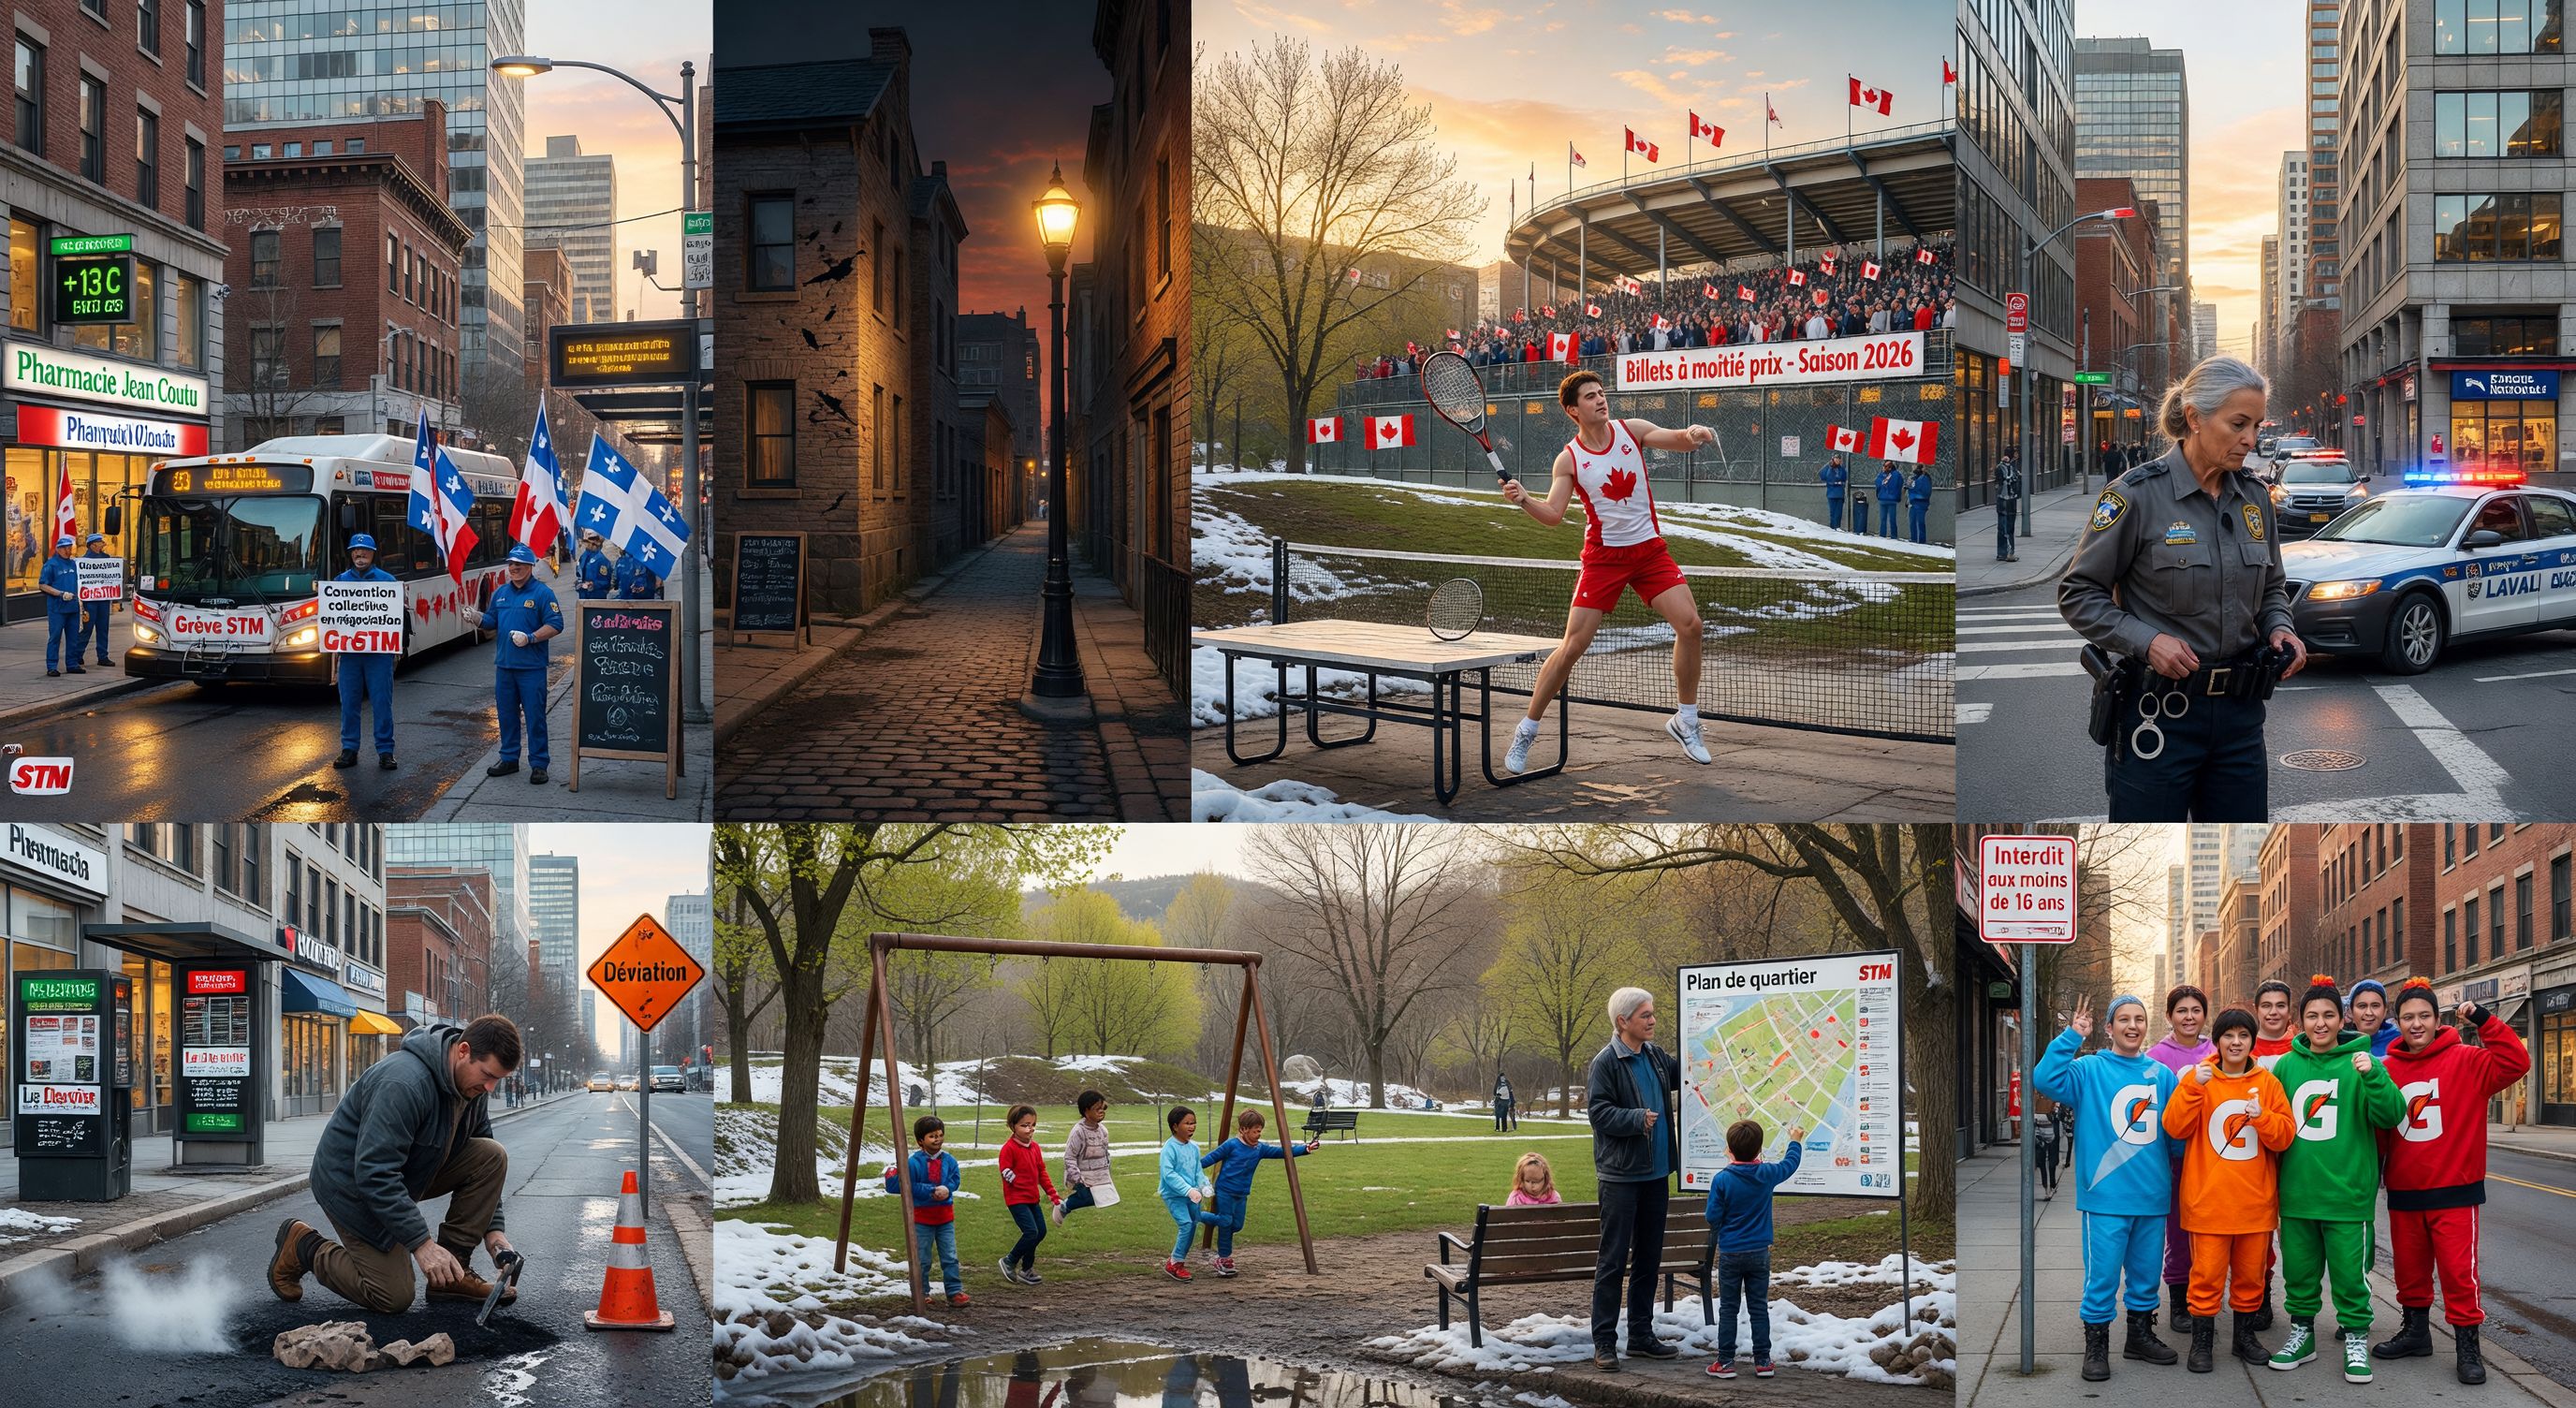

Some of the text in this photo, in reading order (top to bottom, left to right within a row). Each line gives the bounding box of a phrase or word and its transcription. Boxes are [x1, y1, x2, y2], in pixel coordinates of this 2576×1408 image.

[106, 266, 121, 294] C
[1626, 358, 1674, 383] Billets
[1677, 356, 1688, 380] à
[1692, 351, 1745, 379] moitié
[1749, 350, 1783, 384] prix
[1798, 345, 1859, 374] Saison
[1863, 339, 1913, 370] 2026
[17, 350, 198, 407] Pharmacie Jean Coutu
[2485, 574, 2539, 598] LAVAL
[227, 616, 263, 636] STM
[1995, 845, 2065, 866] Interdit
[1987, 872, 2068, 887] aux moins
[1990, 892, 2065, 911] de 16 ans
[604, 961, 687, 982] Déviation
[1687, 967, 1818, 991] Plan de quartier
[1858, 963, 1893, 981] STM
[2110, 1083, 2159, 1146] G
[2291, 1078, 2339, 1141] G
[2396, 1078, 2443, 1142] G
[2208, 1099, 2259, 1161] G
